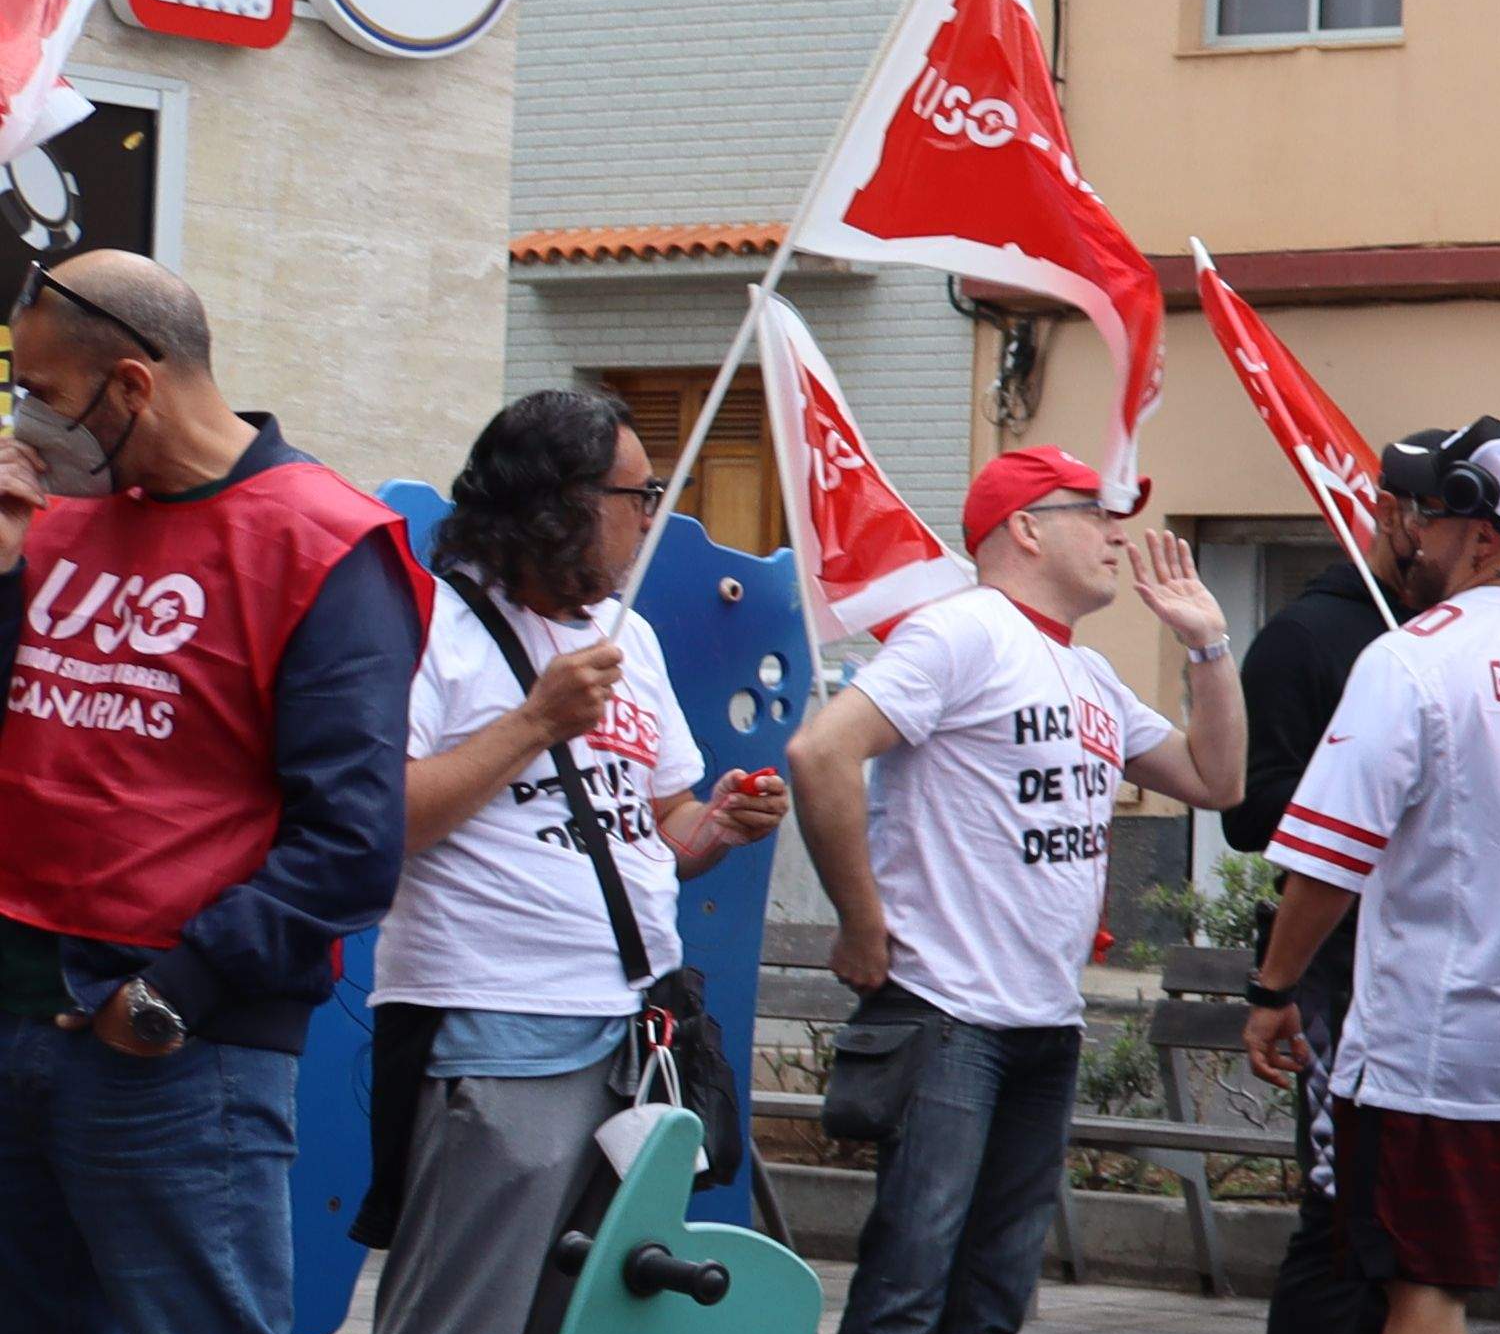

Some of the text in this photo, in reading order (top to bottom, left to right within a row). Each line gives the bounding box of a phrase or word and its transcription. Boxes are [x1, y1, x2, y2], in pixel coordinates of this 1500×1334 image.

[914, 66, 1020, 148] USO
[28, 558, 205, 655] USO
[1014, 705, 1073, 745] HAZ
[1018, 762, 1108, 804] DE TUS
